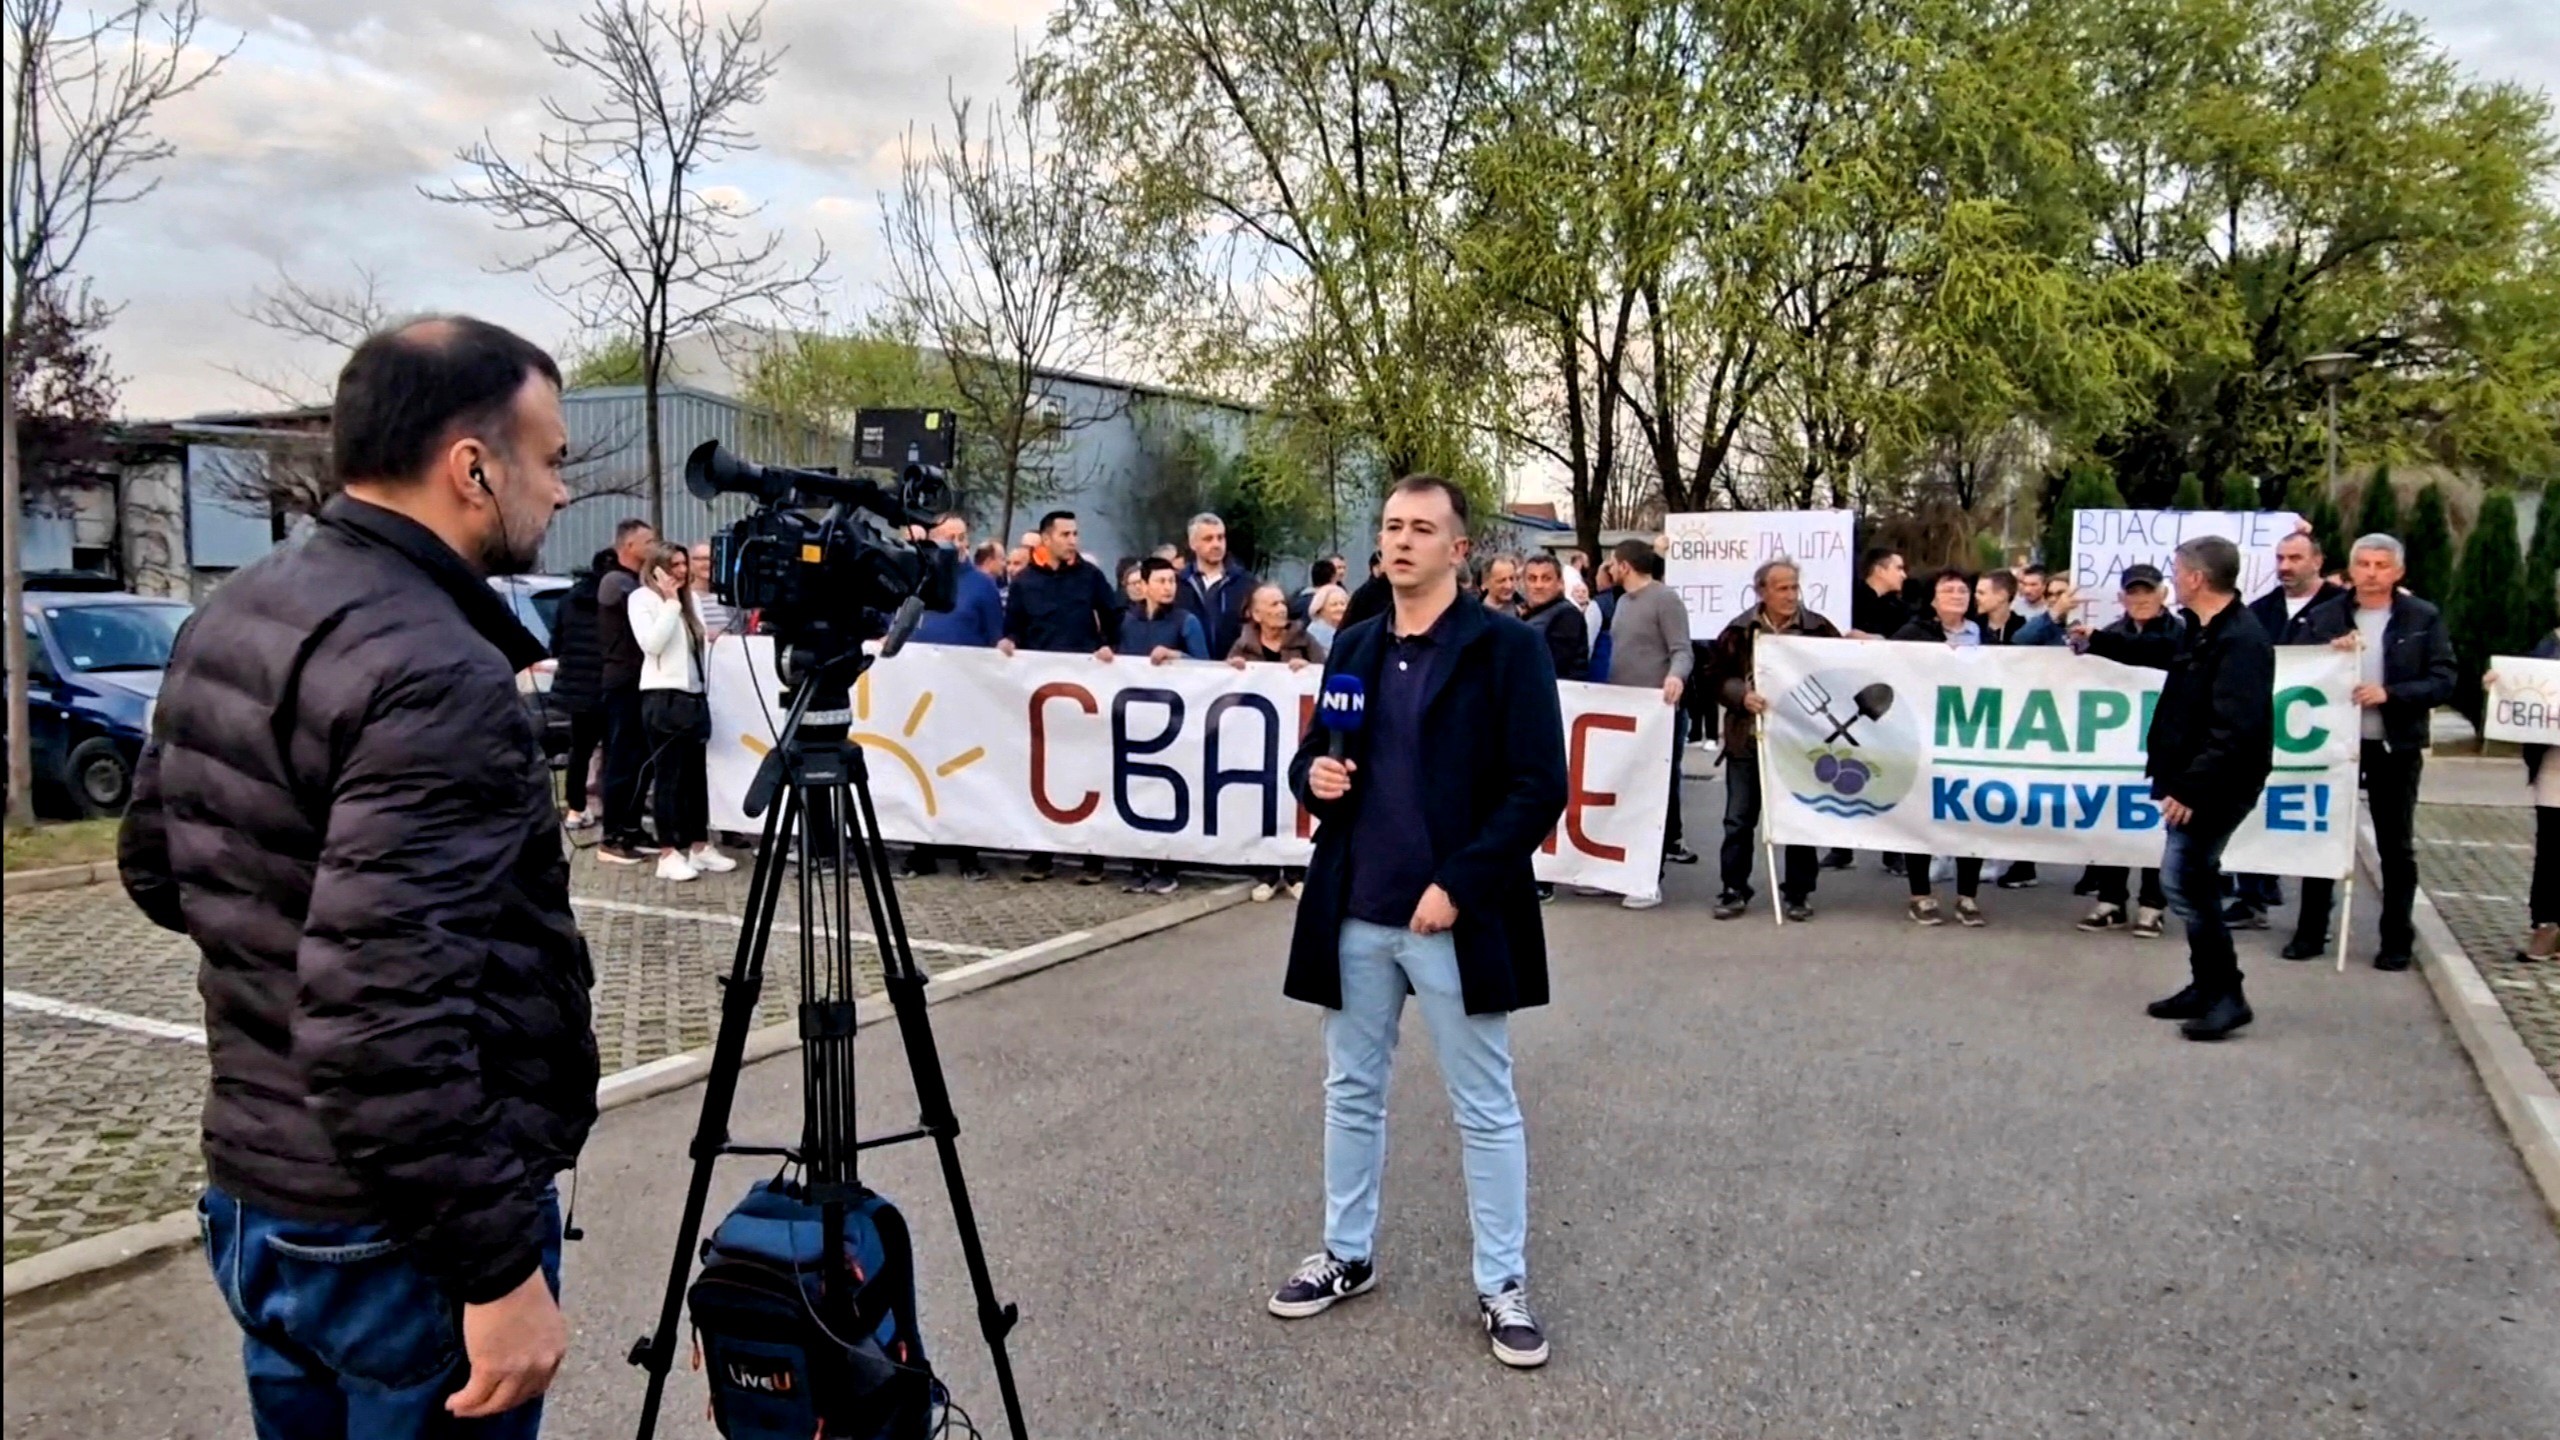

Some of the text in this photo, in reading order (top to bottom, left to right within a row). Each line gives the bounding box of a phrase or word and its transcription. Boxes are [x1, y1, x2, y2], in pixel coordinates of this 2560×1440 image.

[2078, 511, 2192, 546] ВЛАСТ
[1799, 531, 1847, 560] ШТА
[1671, 584, 1723, 613] ЕТЕ
[1029, 682, 1637, 863] СВАЕ
[1932, 776, 2330, 832] КОЛУБЕ!
[728, 1363, 791, 1392] LiveU
